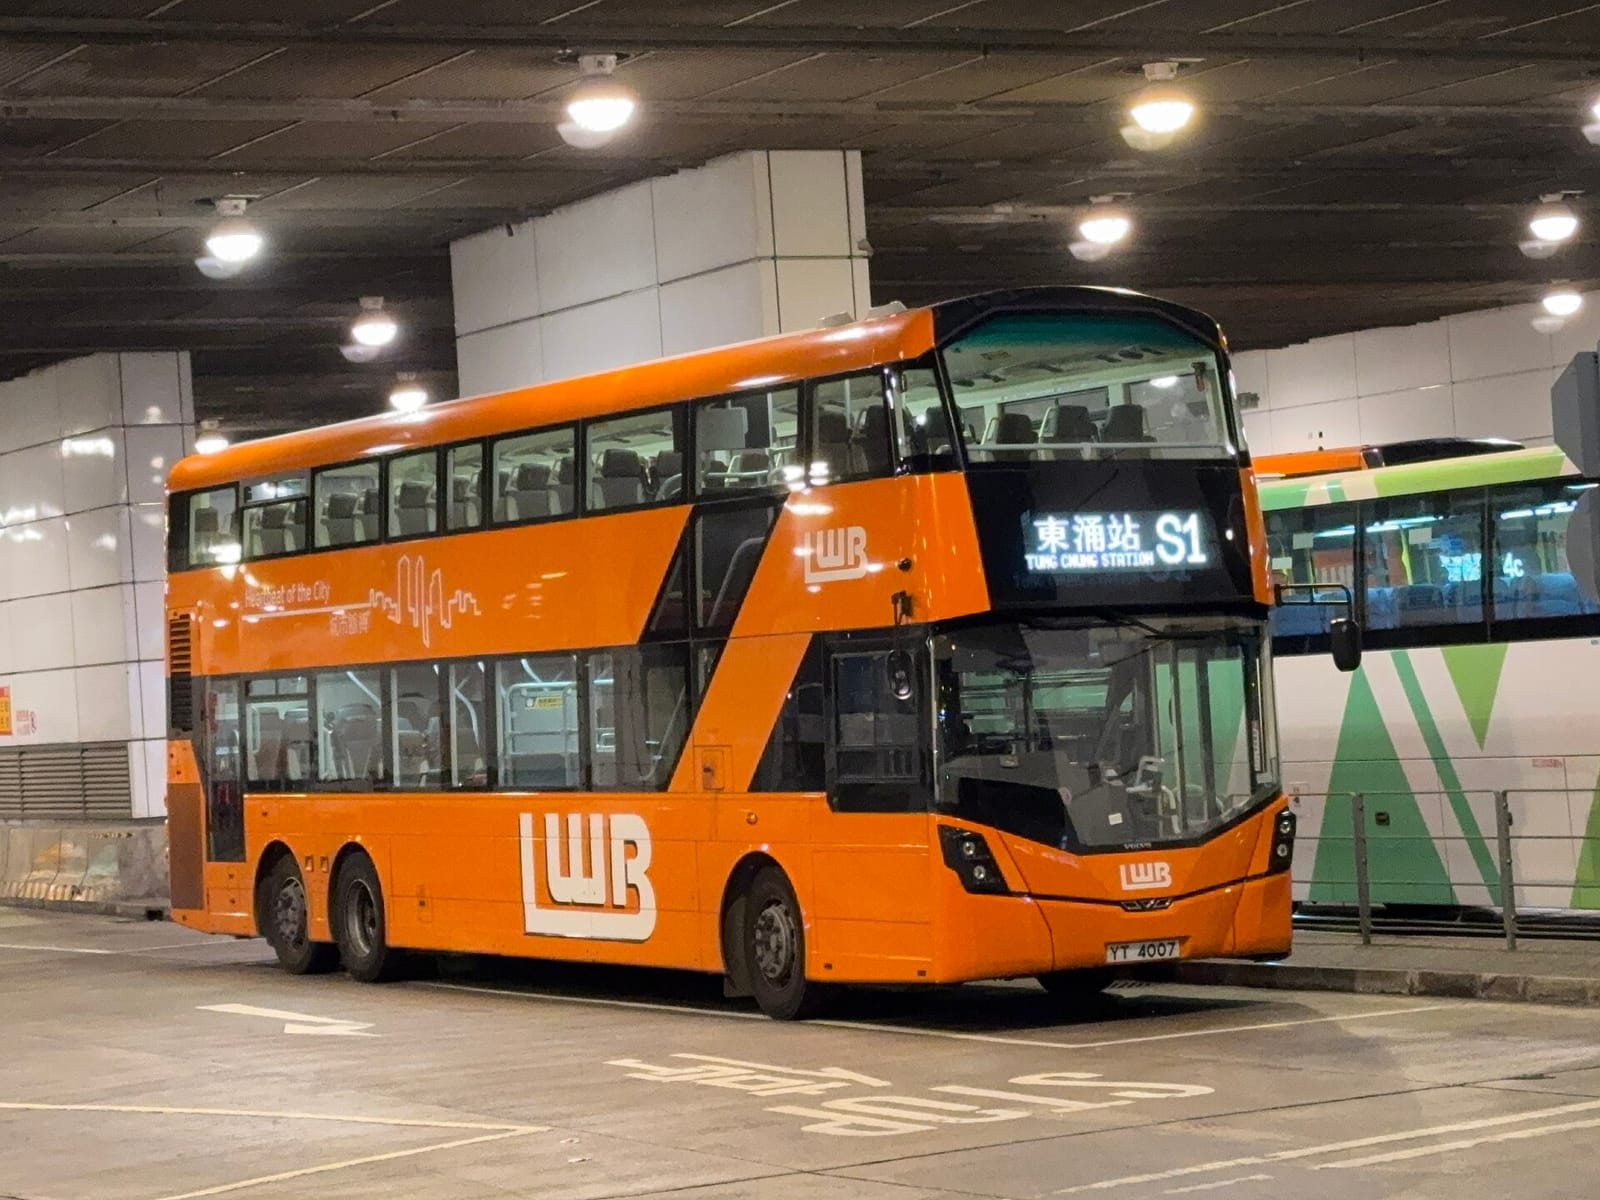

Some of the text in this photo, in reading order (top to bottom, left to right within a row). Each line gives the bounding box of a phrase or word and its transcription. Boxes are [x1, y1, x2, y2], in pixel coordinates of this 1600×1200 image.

[1033, 513, 1140, 552] 東涌站
[1155, 513, 1207, 564] S1
[804, 526, 868, 584] LWB
[1025, 551, 1155, 570] TUNG CHUNG STATION
[286, 584, 297, 603] of
[297, 582, 311, 602] the
[313, 580, 331, 605] City
[519, 812, 657, 940] LWB
[1119, 862, 1172, 891] LWB
[1110, 942, 1176, 960] YT 4007
